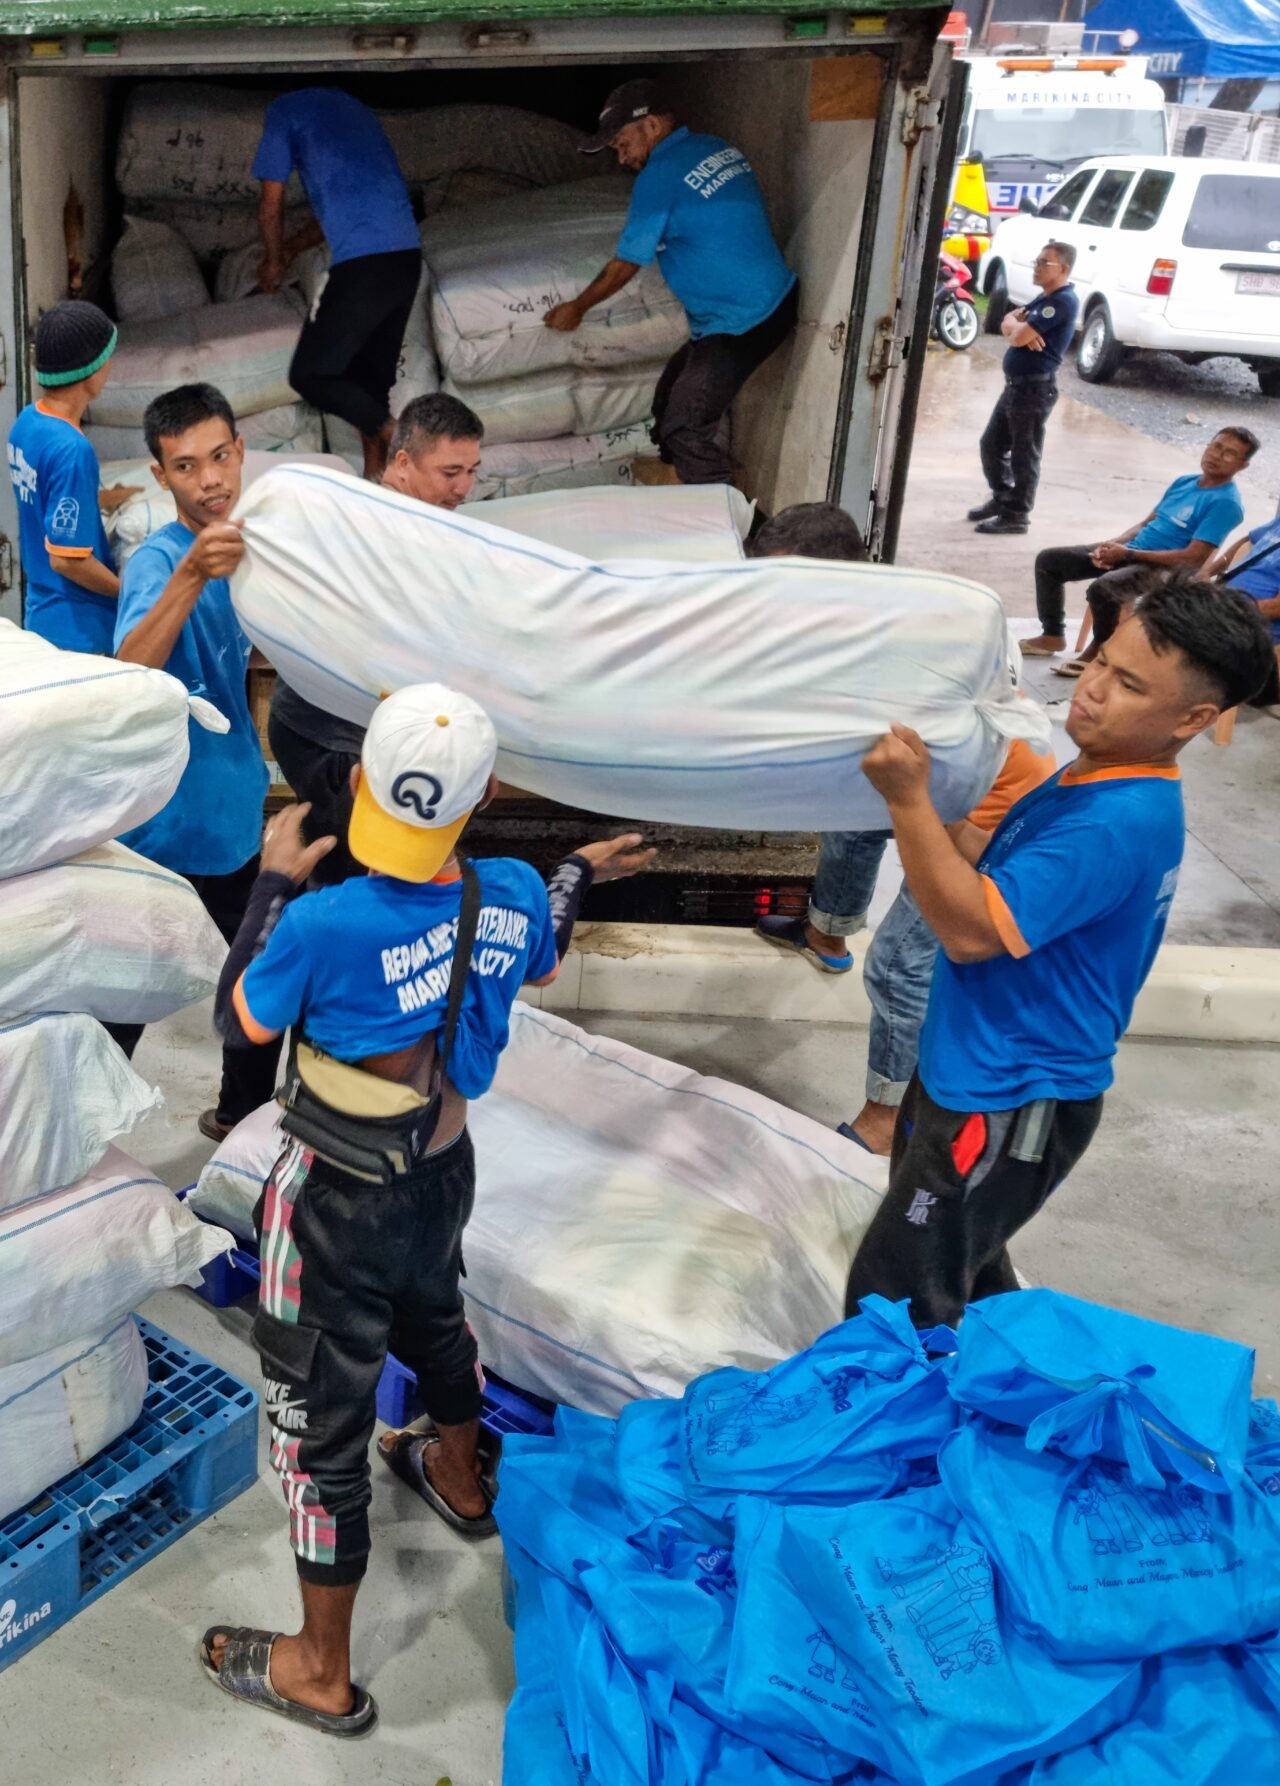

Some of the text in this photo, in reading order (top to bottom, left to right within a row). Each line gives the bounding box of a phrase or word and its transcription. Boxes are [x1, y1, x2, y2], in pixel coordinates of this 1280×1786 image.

[1007, 92, 1133, 104] MARIKINA CITY
[263, 1376, 292, 1404] IKE
[276, 1407, 309, 1430] AIR
[1126, 1574, 1146, 1586] and
[854, 1592, 869, 1612] and
[864, 1610, 887, 1645] Mayor
[875, 1603, 896, 1634] From:
